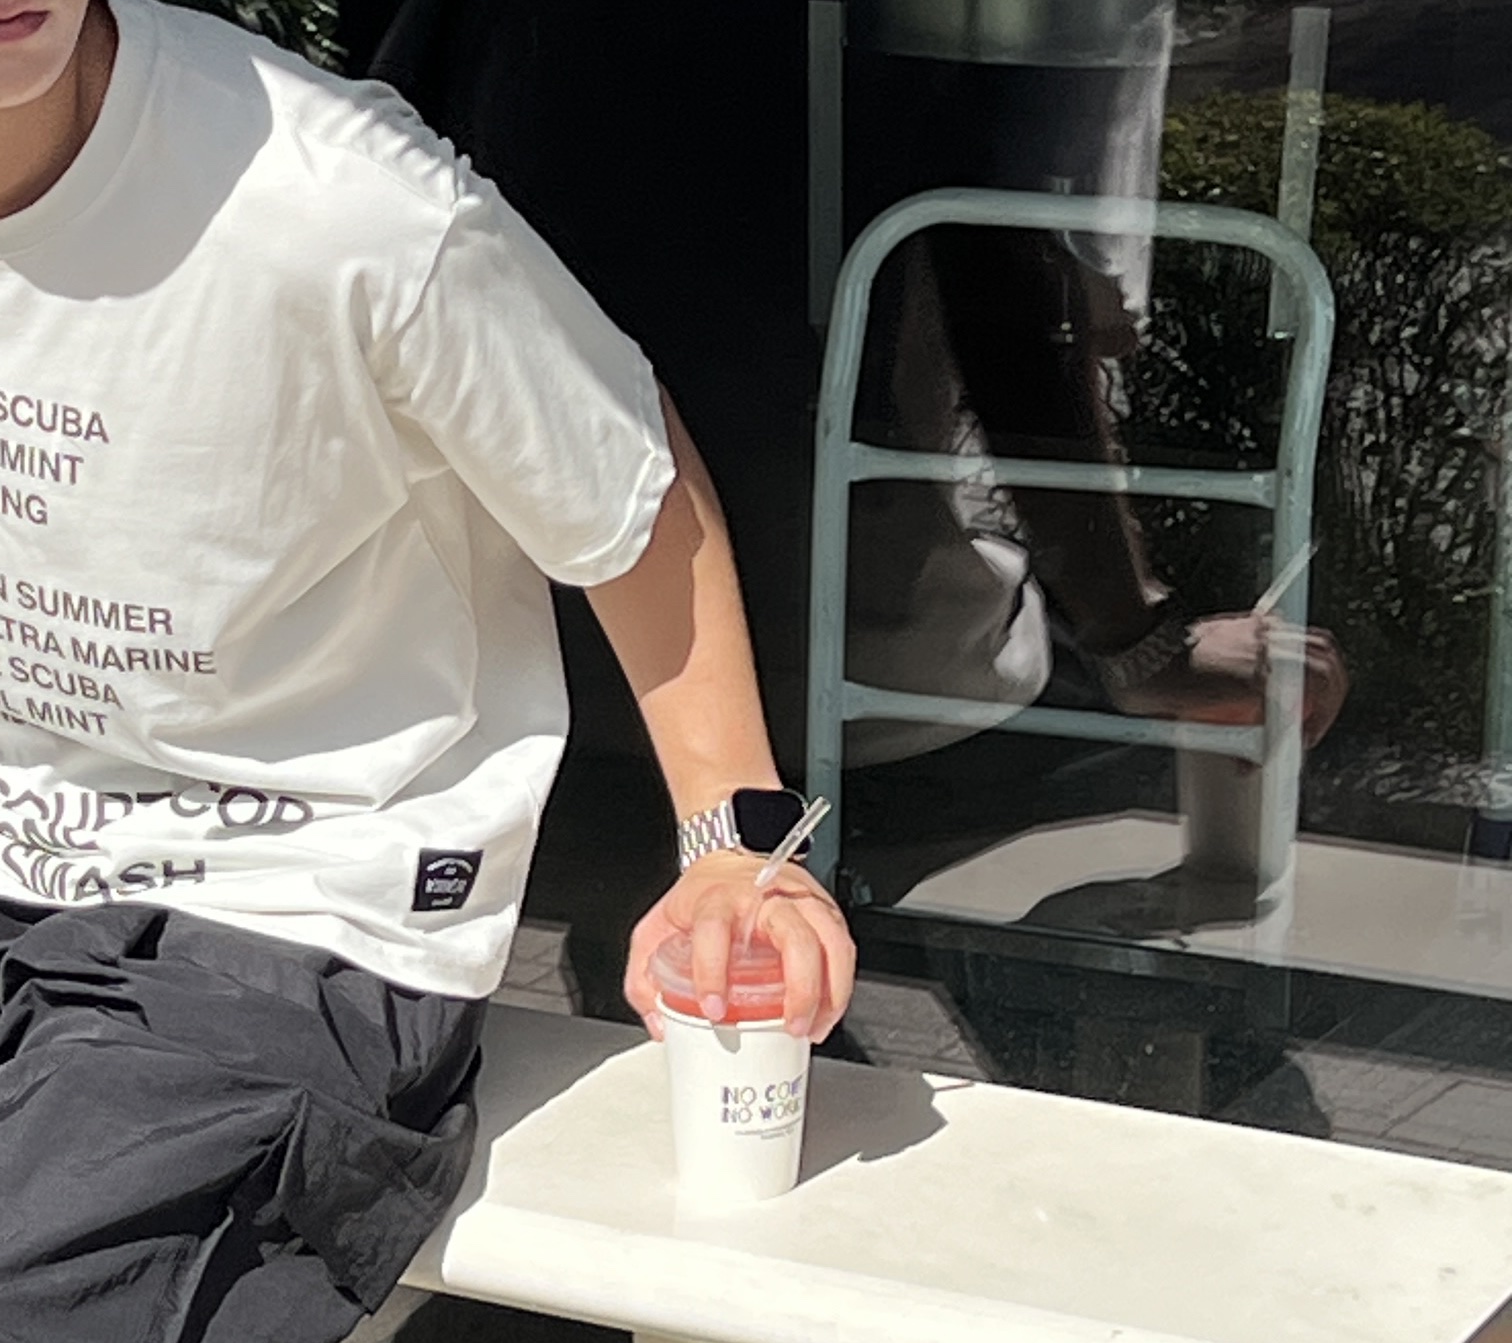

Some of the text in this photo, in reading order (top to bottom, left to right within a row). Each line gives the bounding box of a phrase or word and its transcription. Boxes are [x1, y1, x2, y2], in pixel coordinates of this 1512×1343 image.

[0, 438, 85, 486] MINT
[15, 579, 174, 636] SUMMER
[70, 635, 217, 675] MARINE
[8, 656, 125, 711] SCUBA
[26, 697, 109, 736] MINT
[722, 1086, 757, 1106] NO
